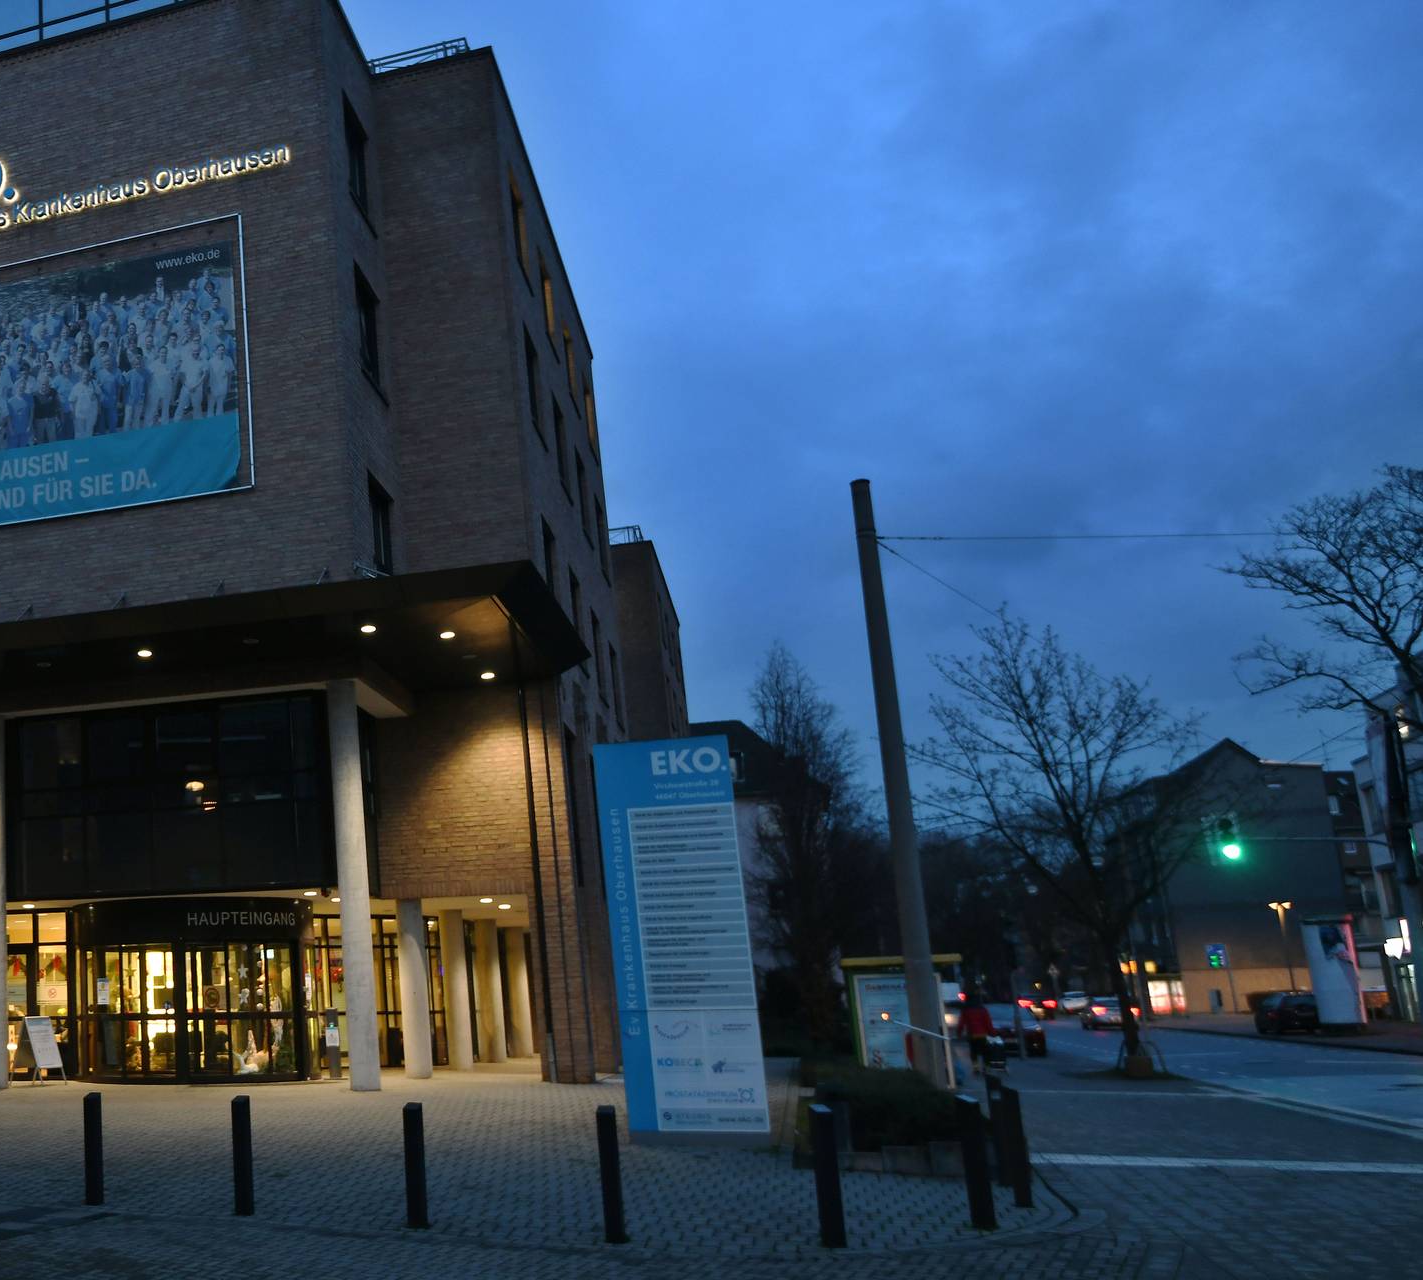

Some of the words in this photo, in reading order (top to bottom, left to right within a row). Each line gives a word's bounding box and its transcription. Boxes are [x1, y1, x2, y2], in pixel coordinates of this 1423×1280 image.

[13, 178, 150, 224] Krankenhaus
[154, 144, 290, 192] Oberhausen
[156, 248, 220, 270] www.eko.de
[32, 477, 73, 506] FÜR
[80, 473, 114, 498] SIE
[121, 467, 157, 493] DA.
[650, 746, 727, 776] EKO.
[610, 807, 628, 901] Oberhausen
[187, 911, 296, 926] HAUPTEINGANG
[618, 905, 640, 1010] Krankenhaus
[628, 1016, 642, 1036] Ev
